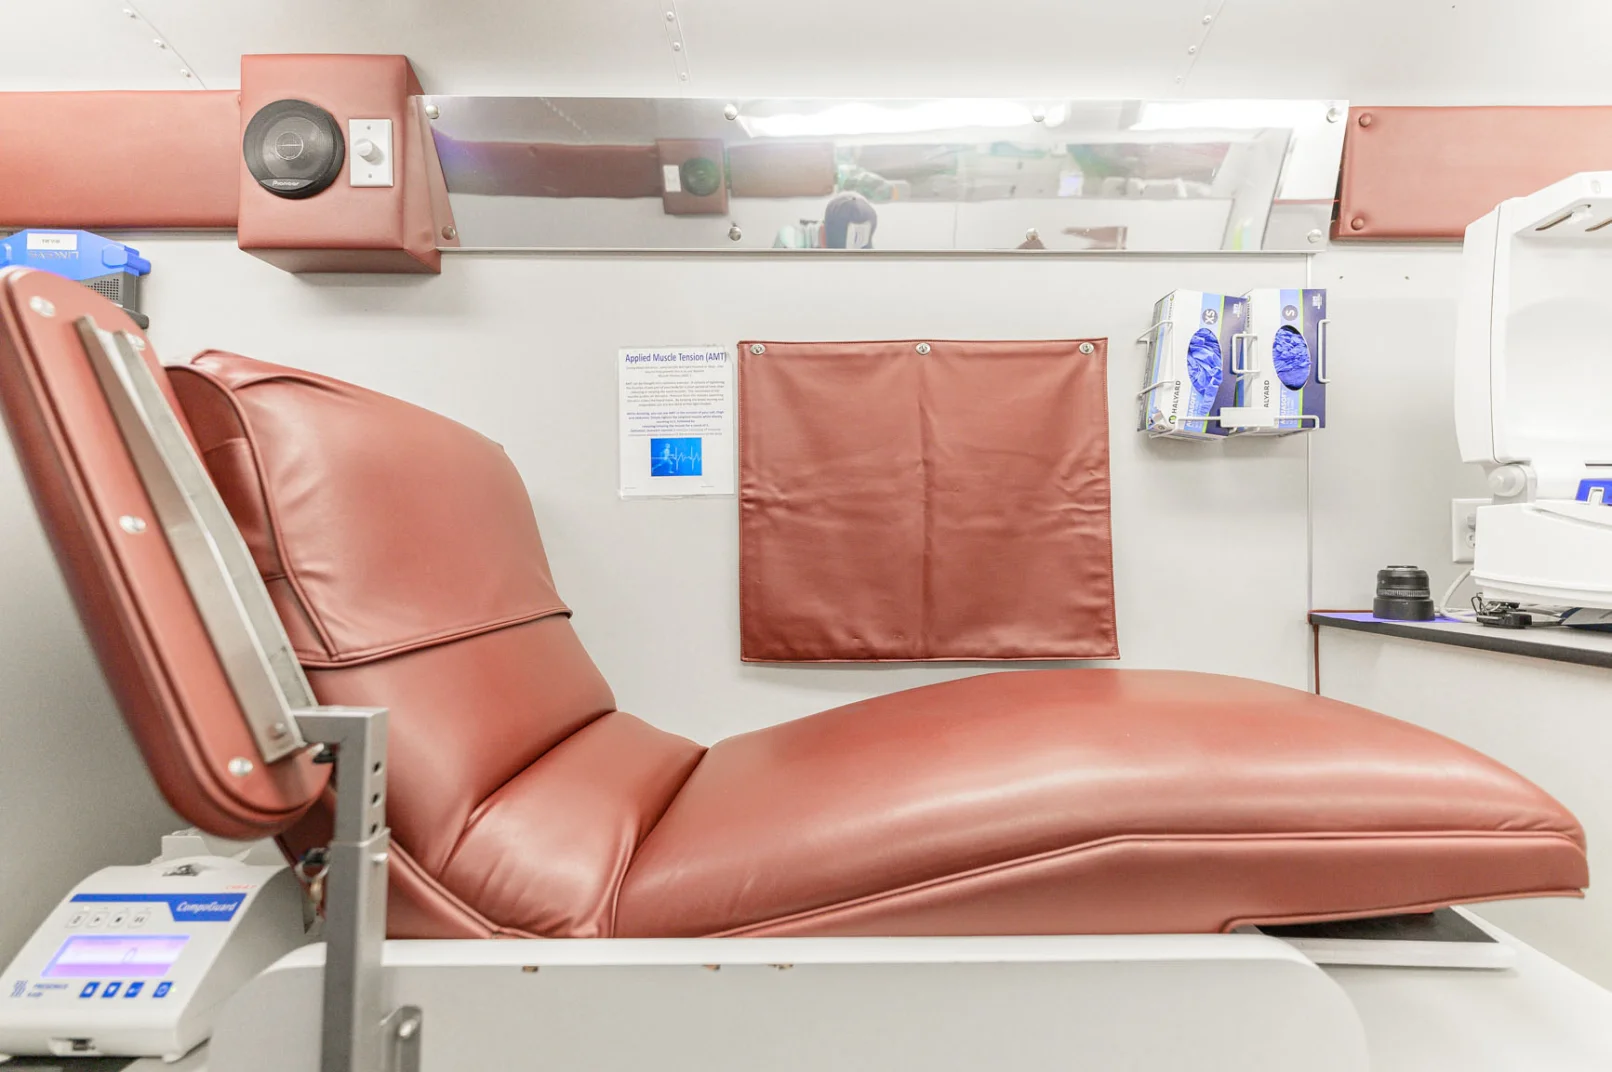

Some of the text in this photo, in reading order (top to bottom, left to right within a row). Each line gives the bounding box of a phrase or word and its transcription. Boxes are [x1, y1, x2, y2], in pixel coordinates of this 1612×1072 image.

[1204, 310, 1215, 324] XS
[1285, 309, 1296, 317] S
[625, 351, 727, 364] Applied Muscle Tension (AMT)
[1172, 380, 1181, 414] HALYARD
[1186, 392, 1197, 427] AUASOFT
[176, 901, 239, 914] CompoGuard
